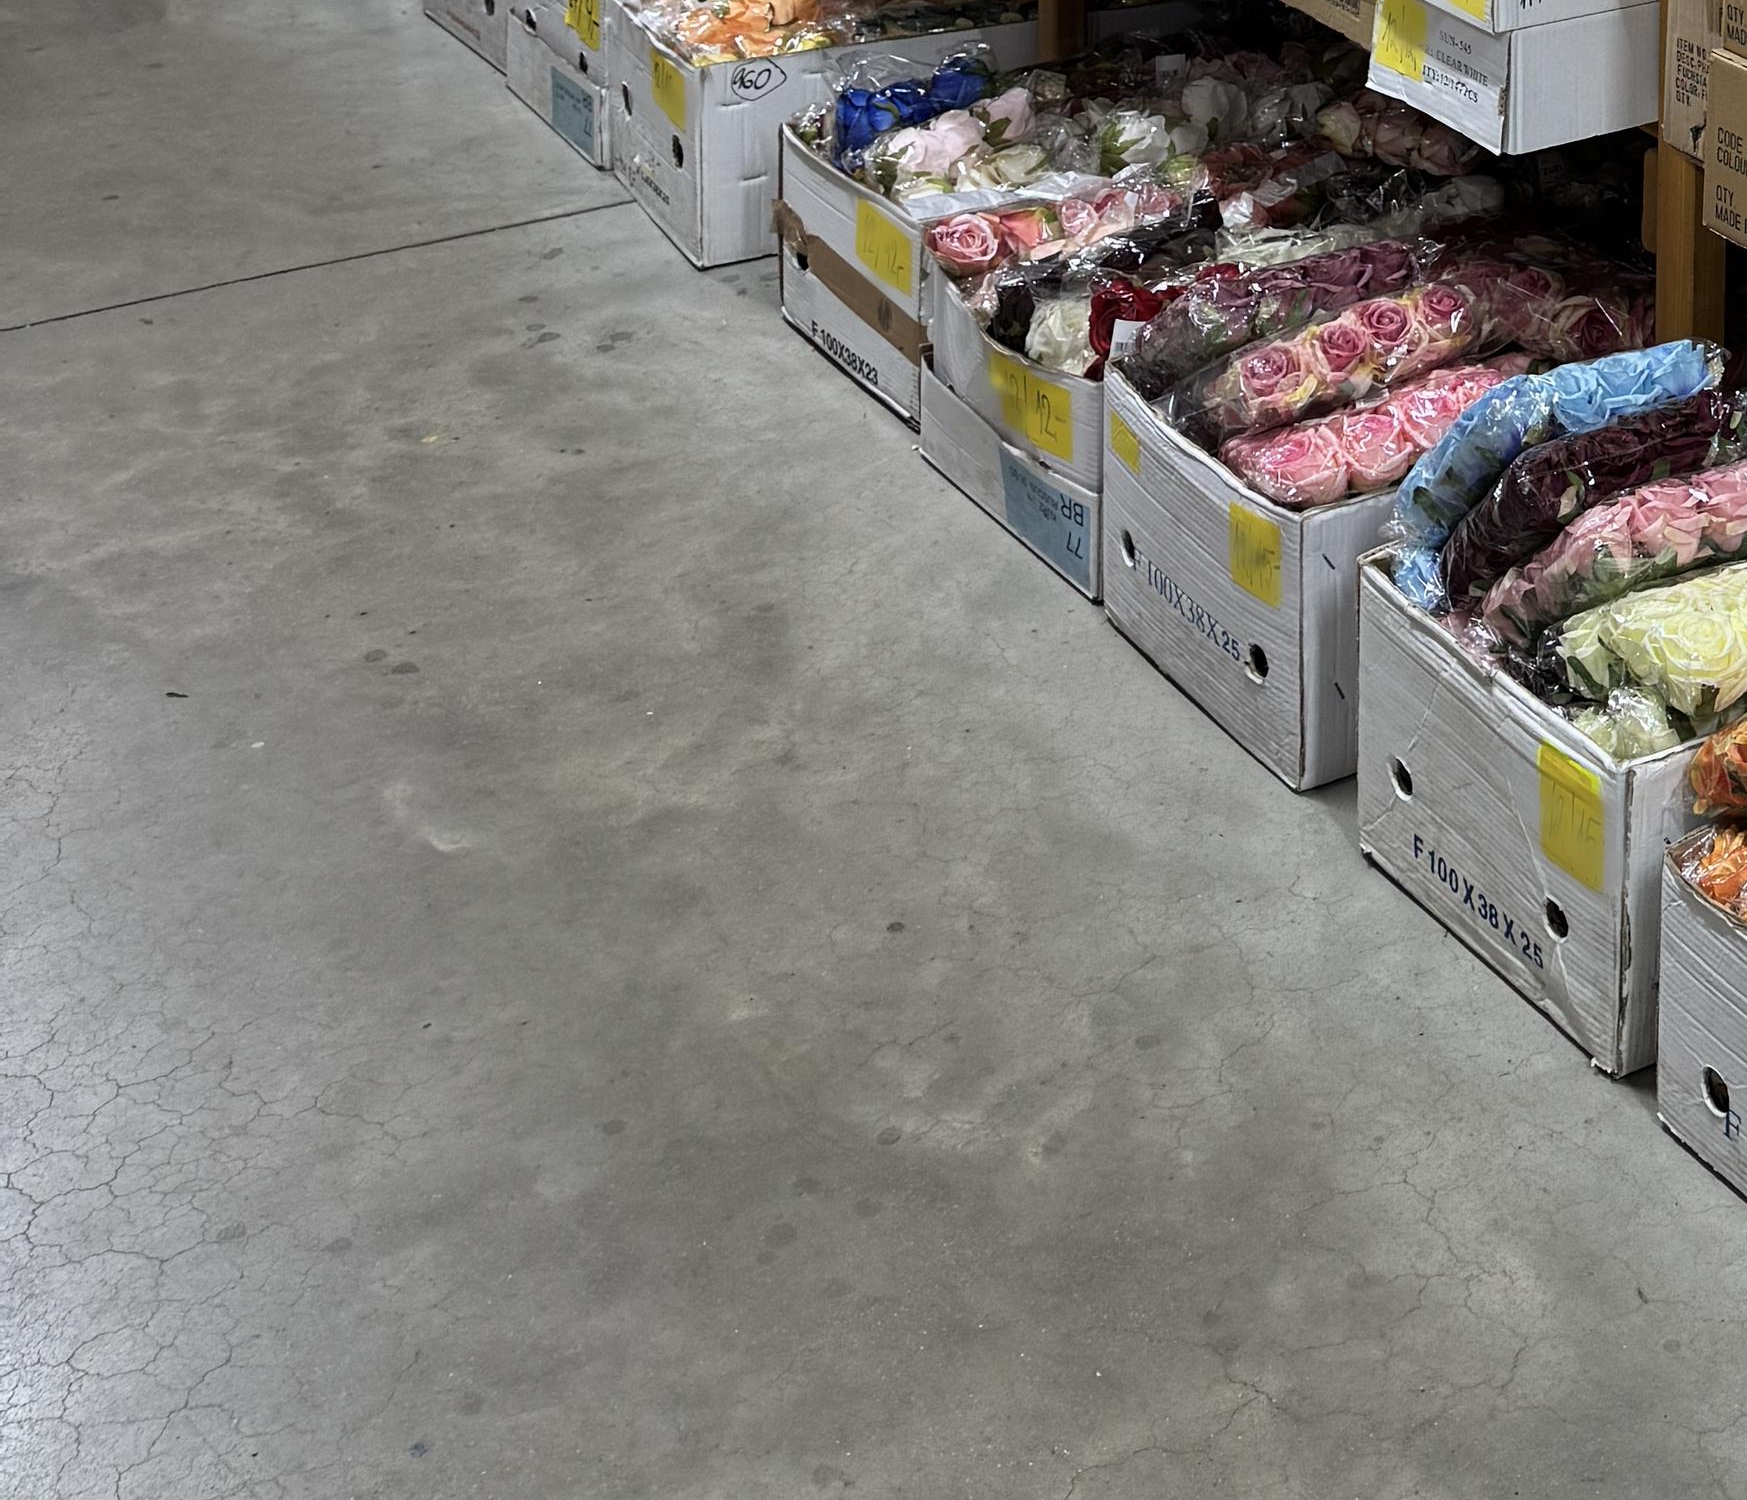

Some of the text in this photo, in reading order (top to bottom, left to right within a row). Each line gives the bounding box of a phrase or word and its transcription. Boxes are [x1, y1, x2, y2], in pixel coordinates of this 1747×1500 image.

[1436, 50, 1488, 88] CLEAR WHITE
[1718, 126, 1744, 154] CODE
[1715, 203, 1742, 232] MADE
[820, 328, 878, 386] 100X38X23
[1060, 492, 1084, 527] BR
[1148, 560, 1241, 662] 100X38X25
[1414, 833, 1424, 859] F
[1722, 1108, 1742, 1140] F
